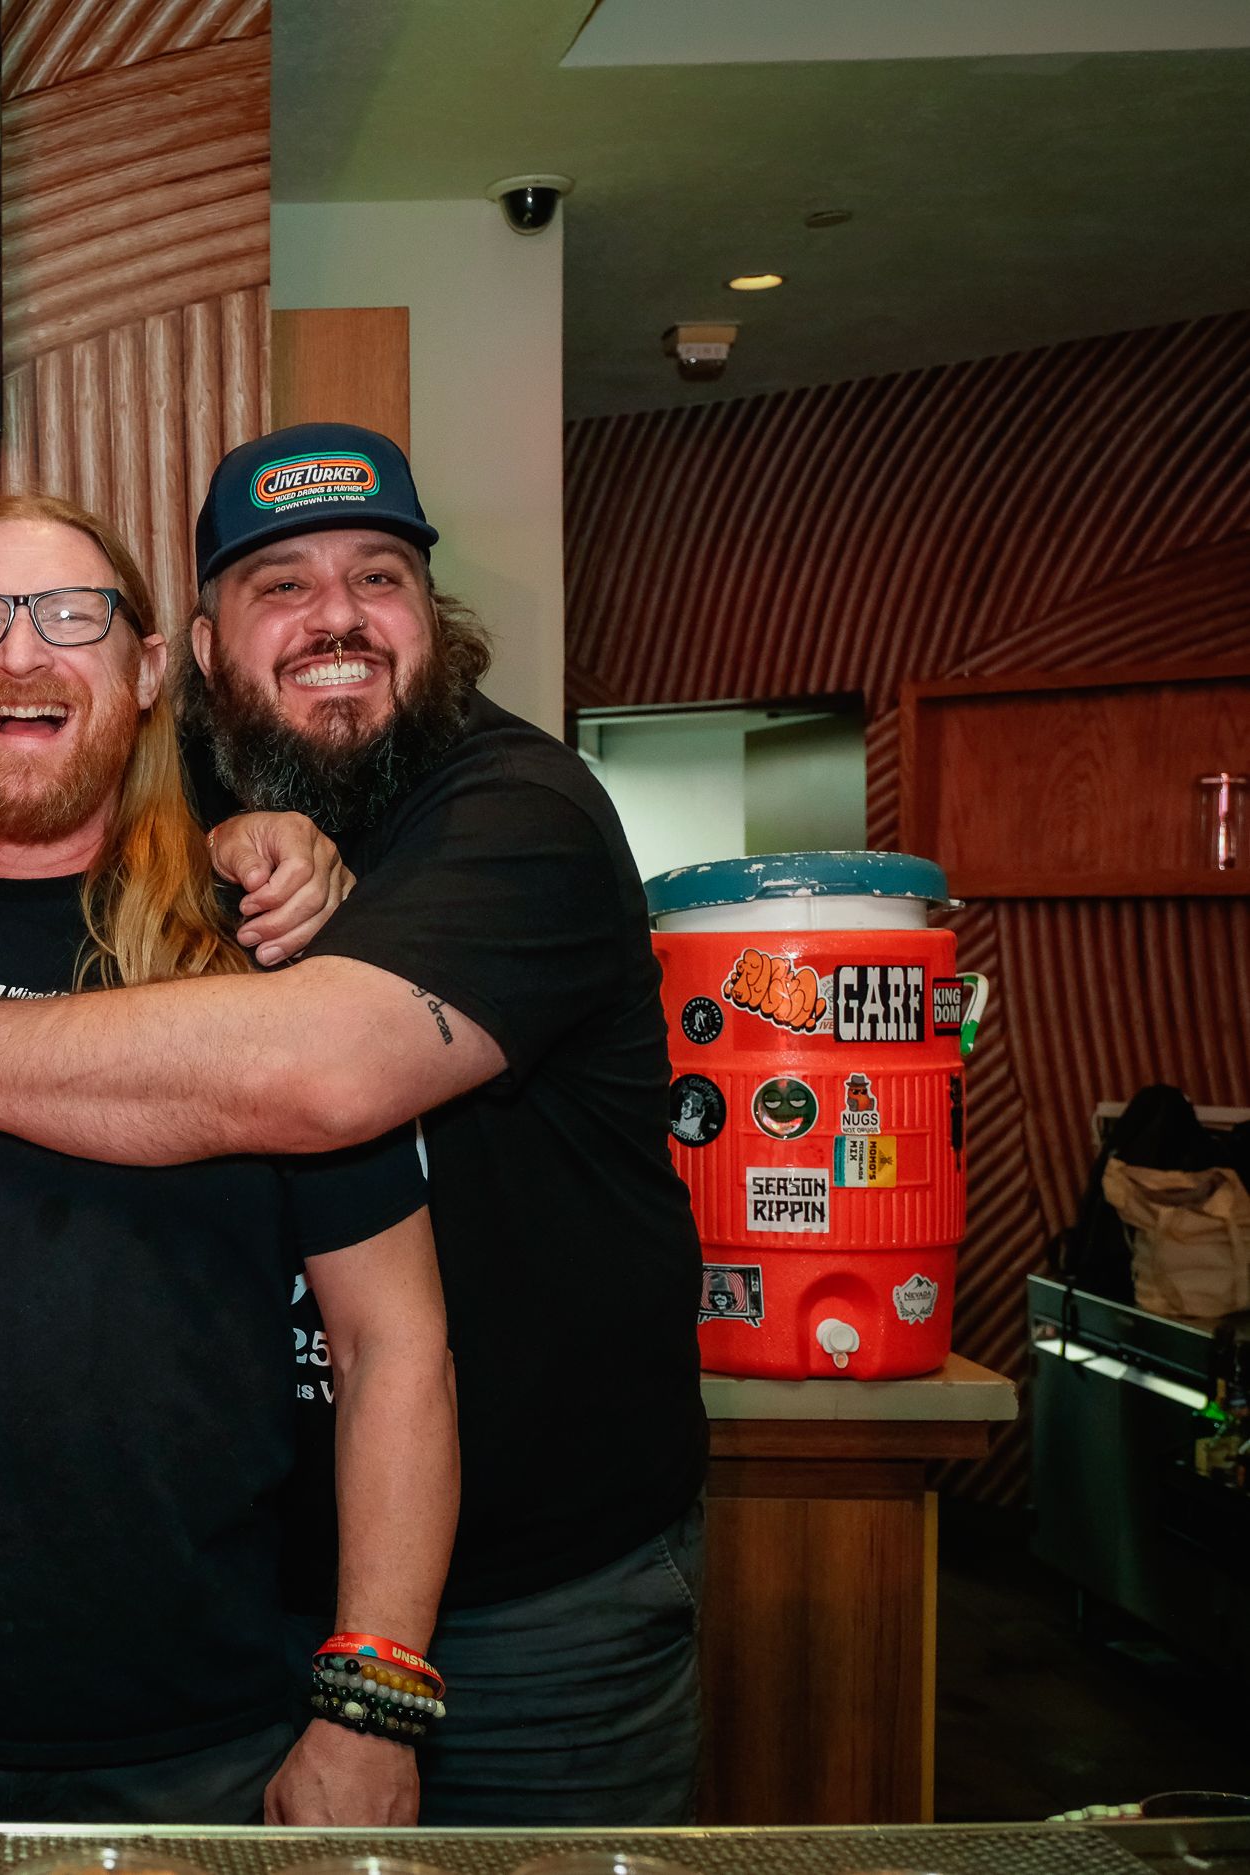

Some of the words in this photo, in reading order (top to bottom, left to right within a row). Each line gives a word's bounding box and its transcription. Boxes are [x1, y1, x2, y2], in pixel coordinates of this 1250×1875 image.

[274, 492, 296, 504] MIXED
[297, 486, 325, 498] DRINKS
[326, 485, 332, 493] &
[333, 485, 363, 493] MAYHEM
[275, 496, 322, 514] DOWNTOWN
[837, 966, 923, 1041] GARF
[933, 988, 961, 1005] KING
[934, 1004, 961, 1023] DOM
[842, 1113, 878, 1126] NUGS
[850, 1140, 858, 1161] MIX
[869, 1141, 877, 1180] MOMO'S
[752, 1176, 827, 1197] SEASON
[753, 1200, 826, 1223] RIPPIN
